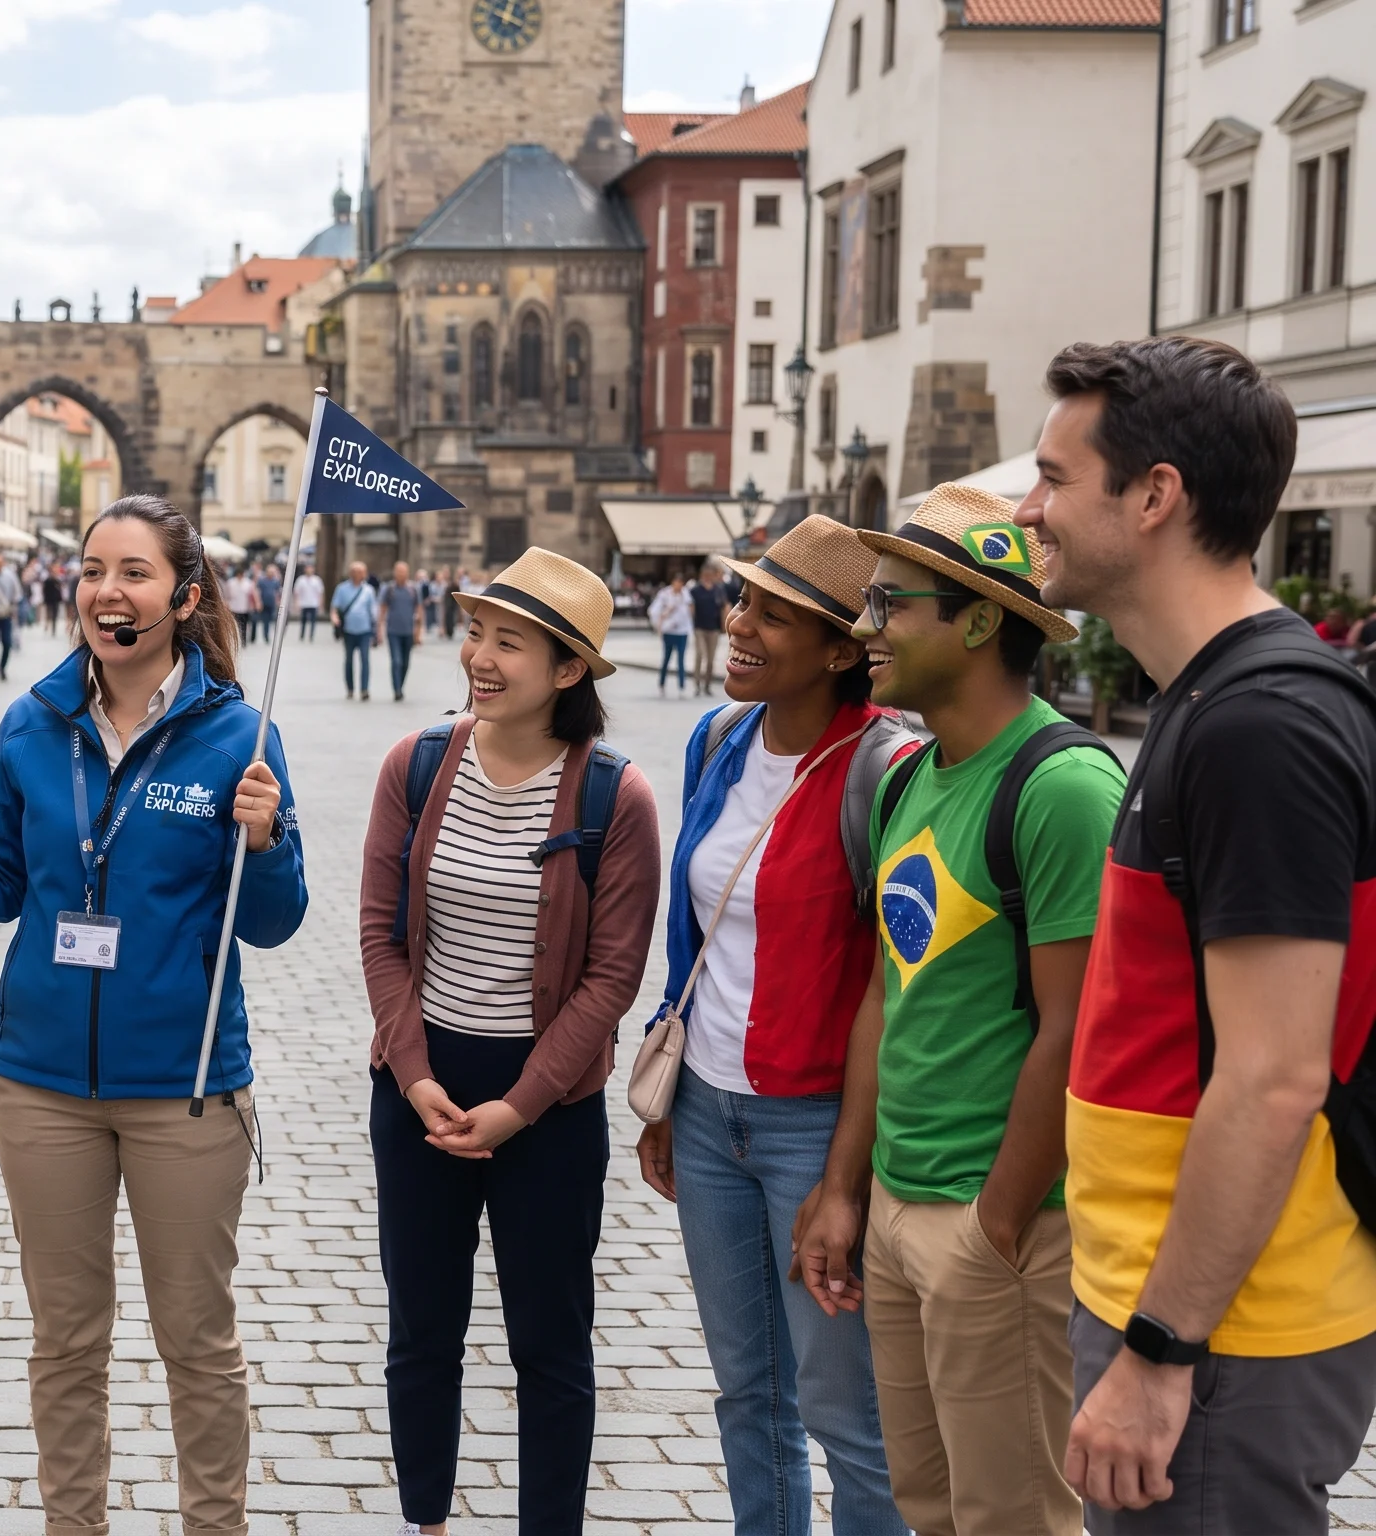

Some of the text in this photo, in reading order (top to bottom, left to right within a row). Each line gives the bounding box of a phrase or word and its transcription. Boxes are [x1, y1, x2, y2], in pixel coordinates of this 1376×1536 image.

[328, 437, 369, 464] CITY
[323, 458, 422, 503] EXPLORERS
[147, 782, 181, 799] CITY
[144, 797, 216, 818] EXPLORERS
